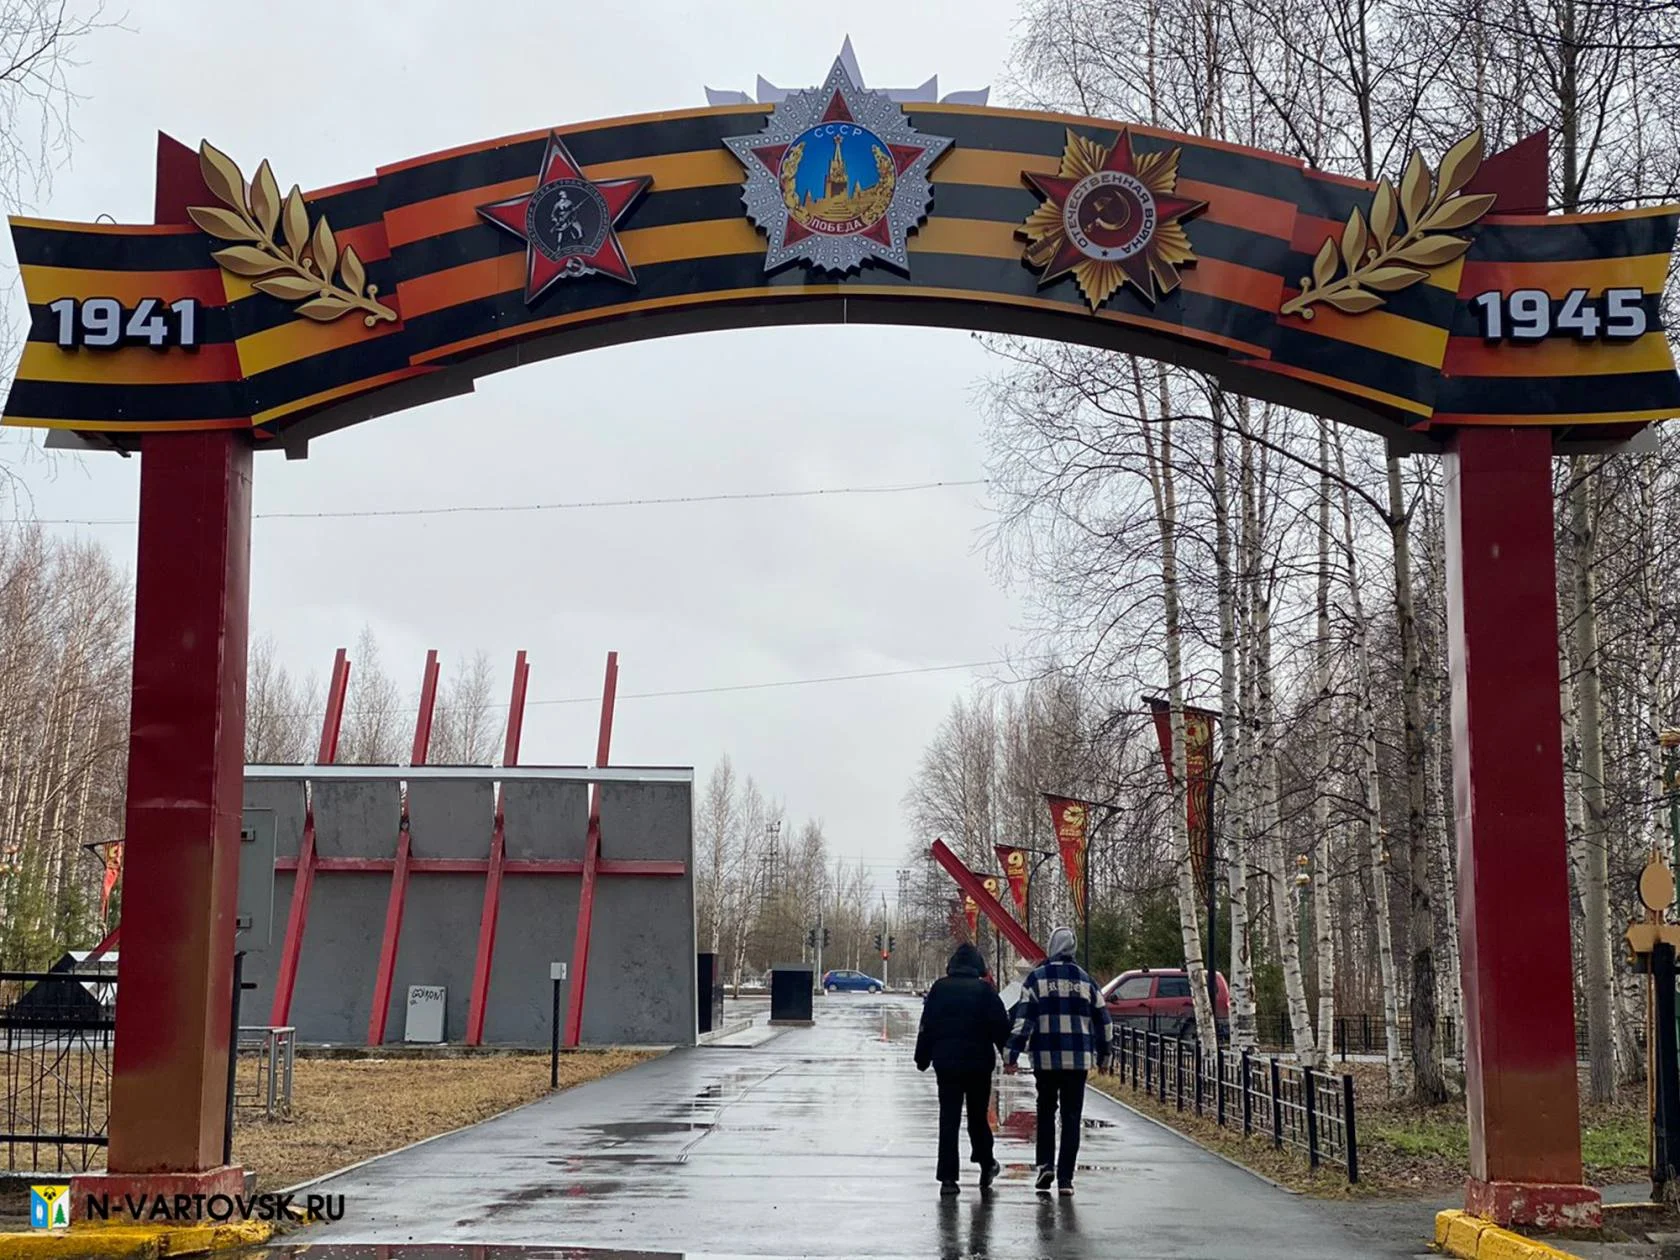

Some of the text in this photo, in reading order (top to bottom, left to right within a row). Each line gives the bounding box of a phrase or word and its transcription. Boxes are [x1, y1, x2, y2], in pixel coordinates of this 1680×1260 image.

[814, 125, 863, 138] СССР
[811, 219, 863, 232] ПОБЕДА
[1067, 173, 1151, 249] ОТЕЧЕСТВЕННАЯ
[50, 298, 195, 346] 1941
[1476, 288, 1647, 338] 1945
[1008, 852, 1024, 869] 9
